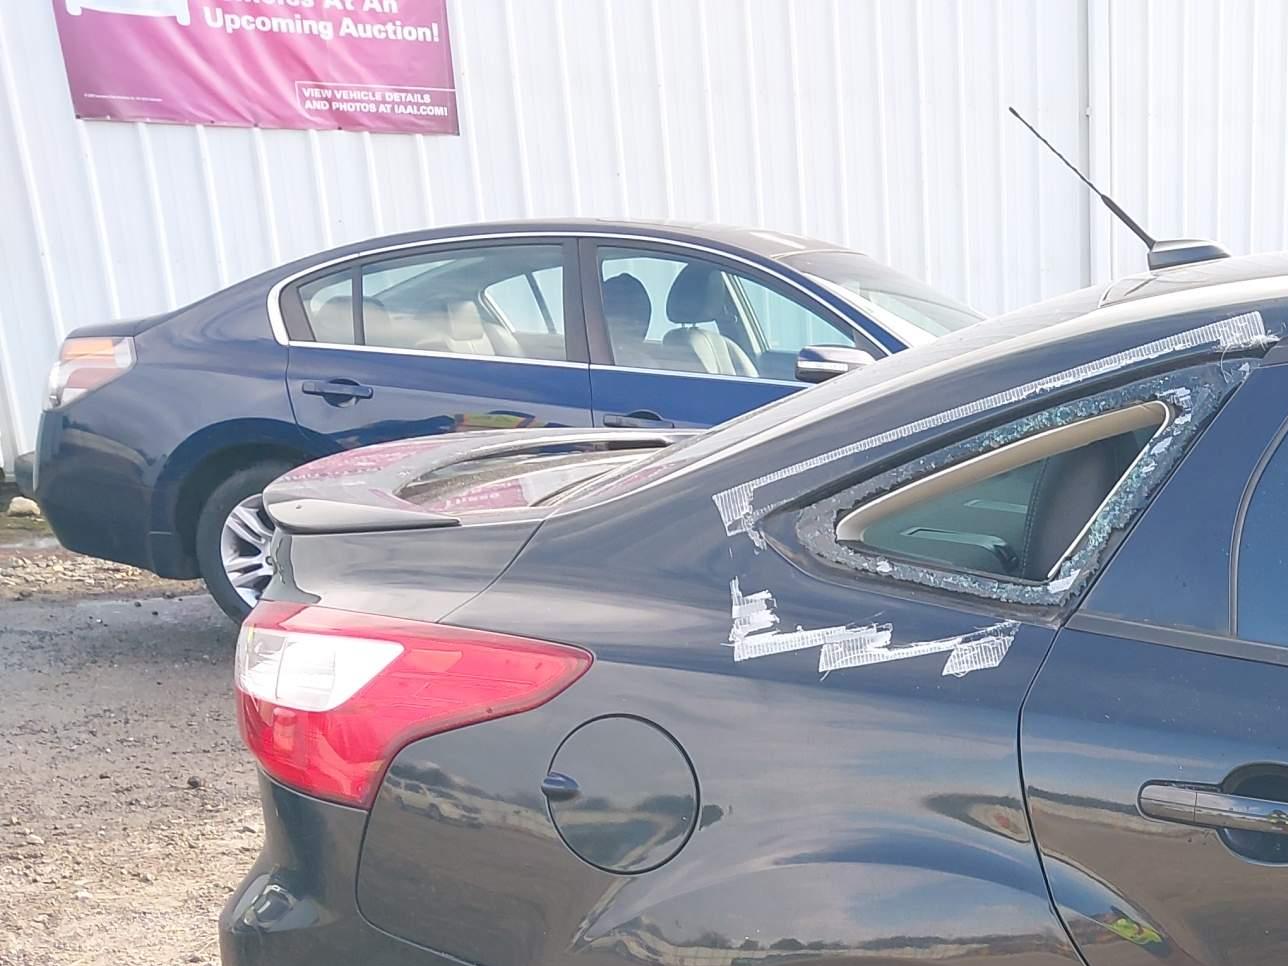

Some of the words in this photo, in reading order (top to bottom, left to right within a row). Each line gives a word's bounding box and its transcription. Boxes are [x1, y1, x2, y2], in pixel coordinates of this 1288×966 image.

[203, 6, 333, 41] Upcoming
[339, 17, 440, 42] Auction!
[302, 87, 333, 99] VIEW
[334, 90, 382, 101] VEHICLE
[385, 92, 431, 104] DETAILS
[304, 100, 330, 111] AND
[332, 102, 377, 113] PHOTOS
[378, 103, 392, 113] AT
